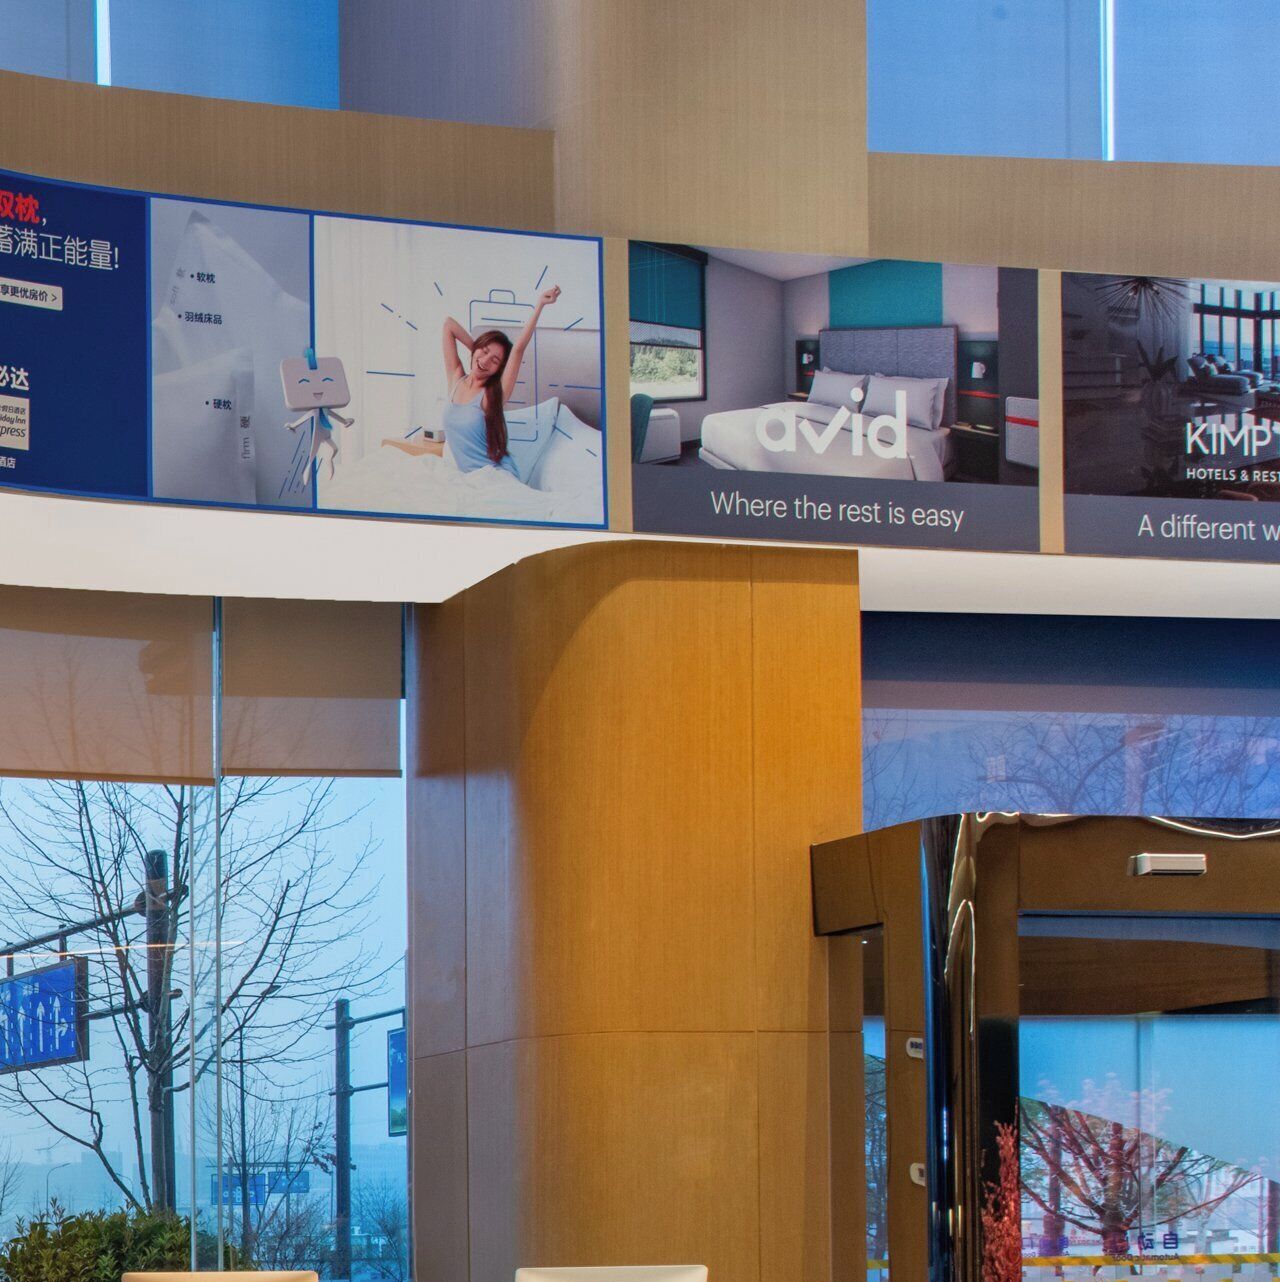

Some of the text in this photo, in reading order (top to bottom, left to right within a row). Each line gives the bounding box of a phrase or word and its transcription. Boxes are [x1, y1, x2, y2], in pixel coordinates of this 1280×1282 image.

[196, 272, 216, 284] 软枕
[184, 311, 222, 325] 羽绒床品
[213, 399, 232, 410] 硬枕
[15, 415, 26, 425] Inn
[756, 387, 908, 459] avid
[242, 437, 250, 459] firm
[1186, 468, 1236, 481] HOTELS
[1240, 470, 1249, 481] &
[710, 491, 965, 532] Where the rest is easy
[1138, 514, 1154, 537] A
[1160, 514, 1256, 541] different
